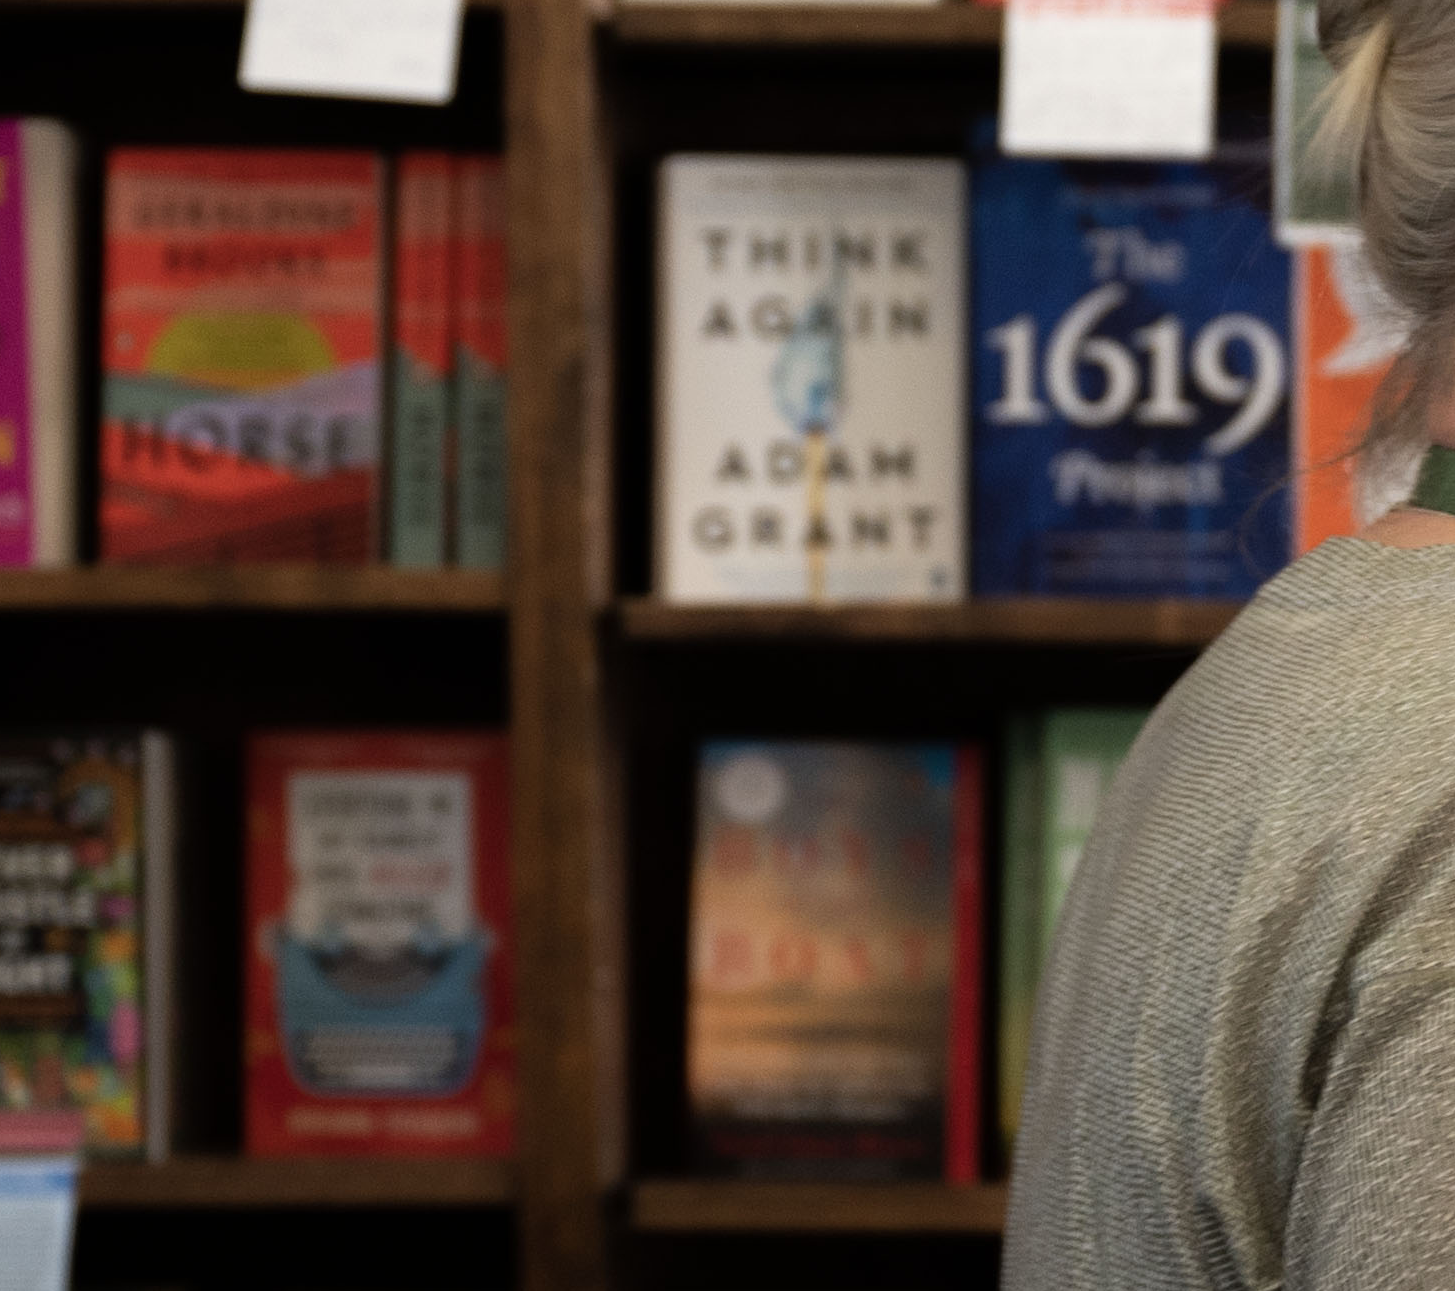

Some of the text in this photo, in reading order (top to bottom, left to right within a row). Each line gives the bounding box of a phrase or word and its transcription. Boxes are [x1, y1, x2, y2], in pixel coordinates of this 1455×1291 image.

[703, 232, 929, 271] THINK
[1081, 231, 1185, 278] The
[703, 301, 931, 336] AGAIN
[986, 284, 1284, 453] 1619
[123, 410, 352, 472] HORSE
[718, 445, 917, 482] ADAM
[693, 512, 937, 549] GRANT
